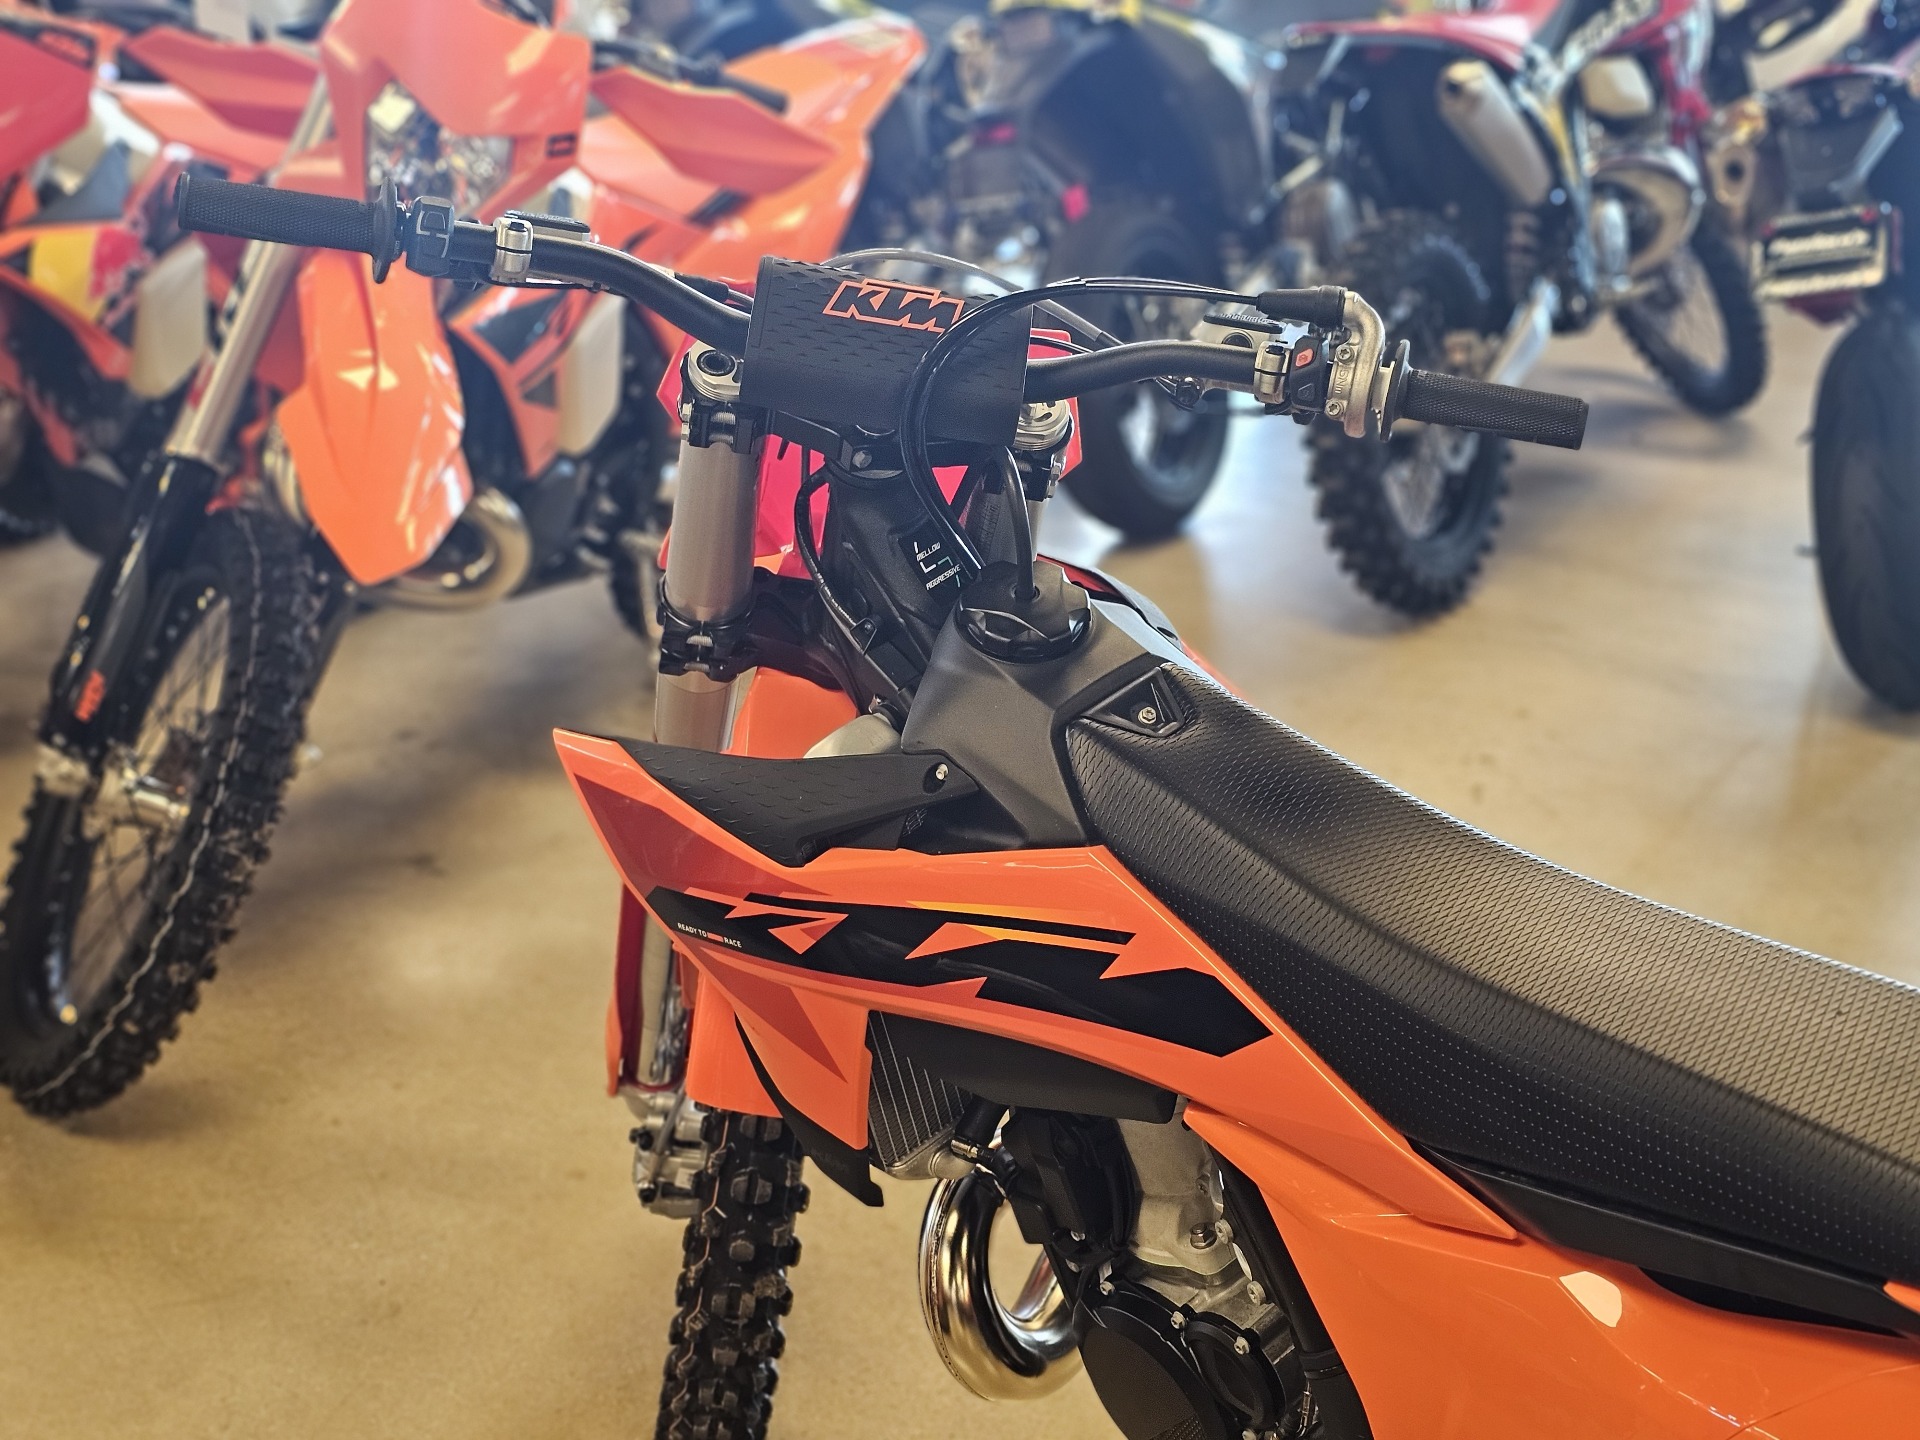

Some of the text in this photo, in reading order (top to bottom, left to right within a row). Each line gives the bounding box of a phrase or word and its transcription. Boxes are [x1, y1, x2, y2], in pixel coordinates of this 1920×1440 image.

[823, 279, 966, 333] KTM
[916, 541, 941, 562] MELLOW
[925, 563, 962, 591] AGGRESSIVE
[677, 922, 743, 948] READY TO RACE
